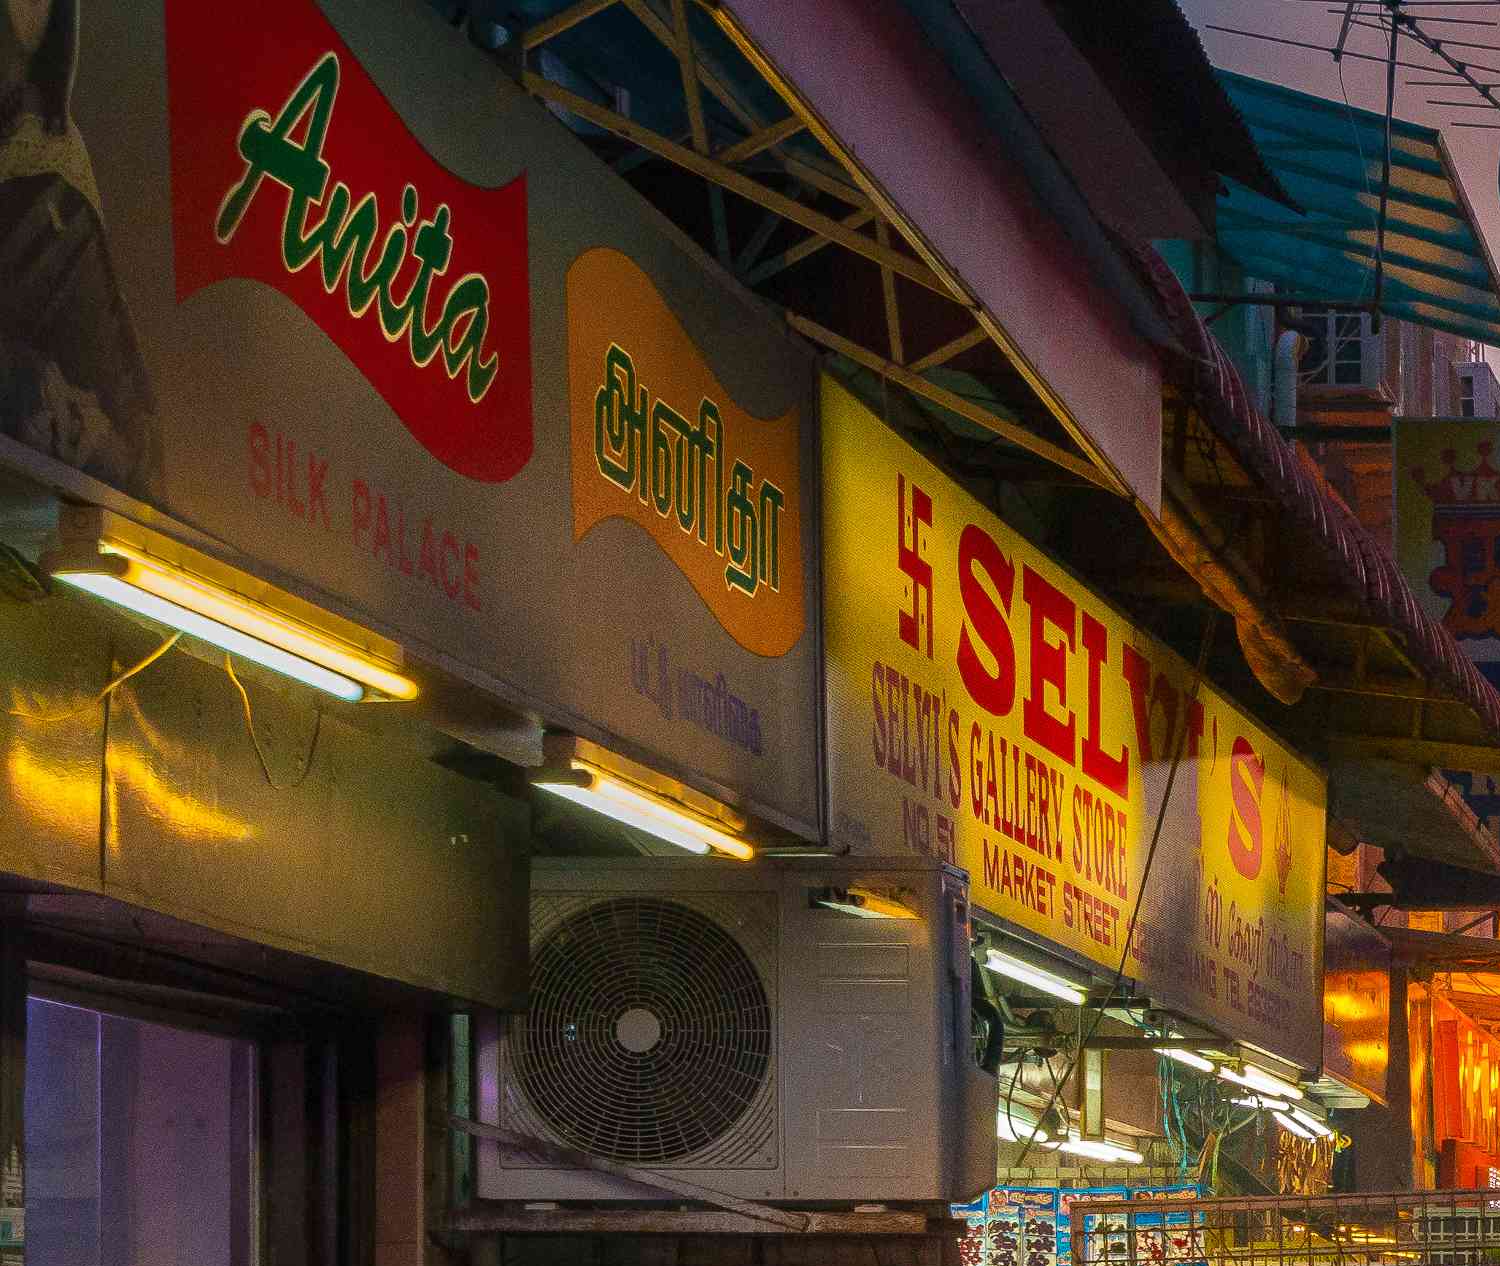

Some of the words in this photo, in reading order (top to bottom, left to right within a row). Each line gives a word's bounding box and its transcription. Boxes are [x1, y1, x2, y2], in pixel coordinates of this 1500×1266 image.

[214, 51, 498, 404] Anita
[248, 421, 331, 532] SILK
[350, 478, 482, 613] PALACE
[595, 343, 783, 599] அனிதா
[871, 661, 962, 810] SELVI'S
[969, 720, 1065, 865] GALLERY
[1072, 784, 1128, 901] STORE
[982, 838, 1057, 919] MARKET
[1063, 880, 1121, 949] STREET
